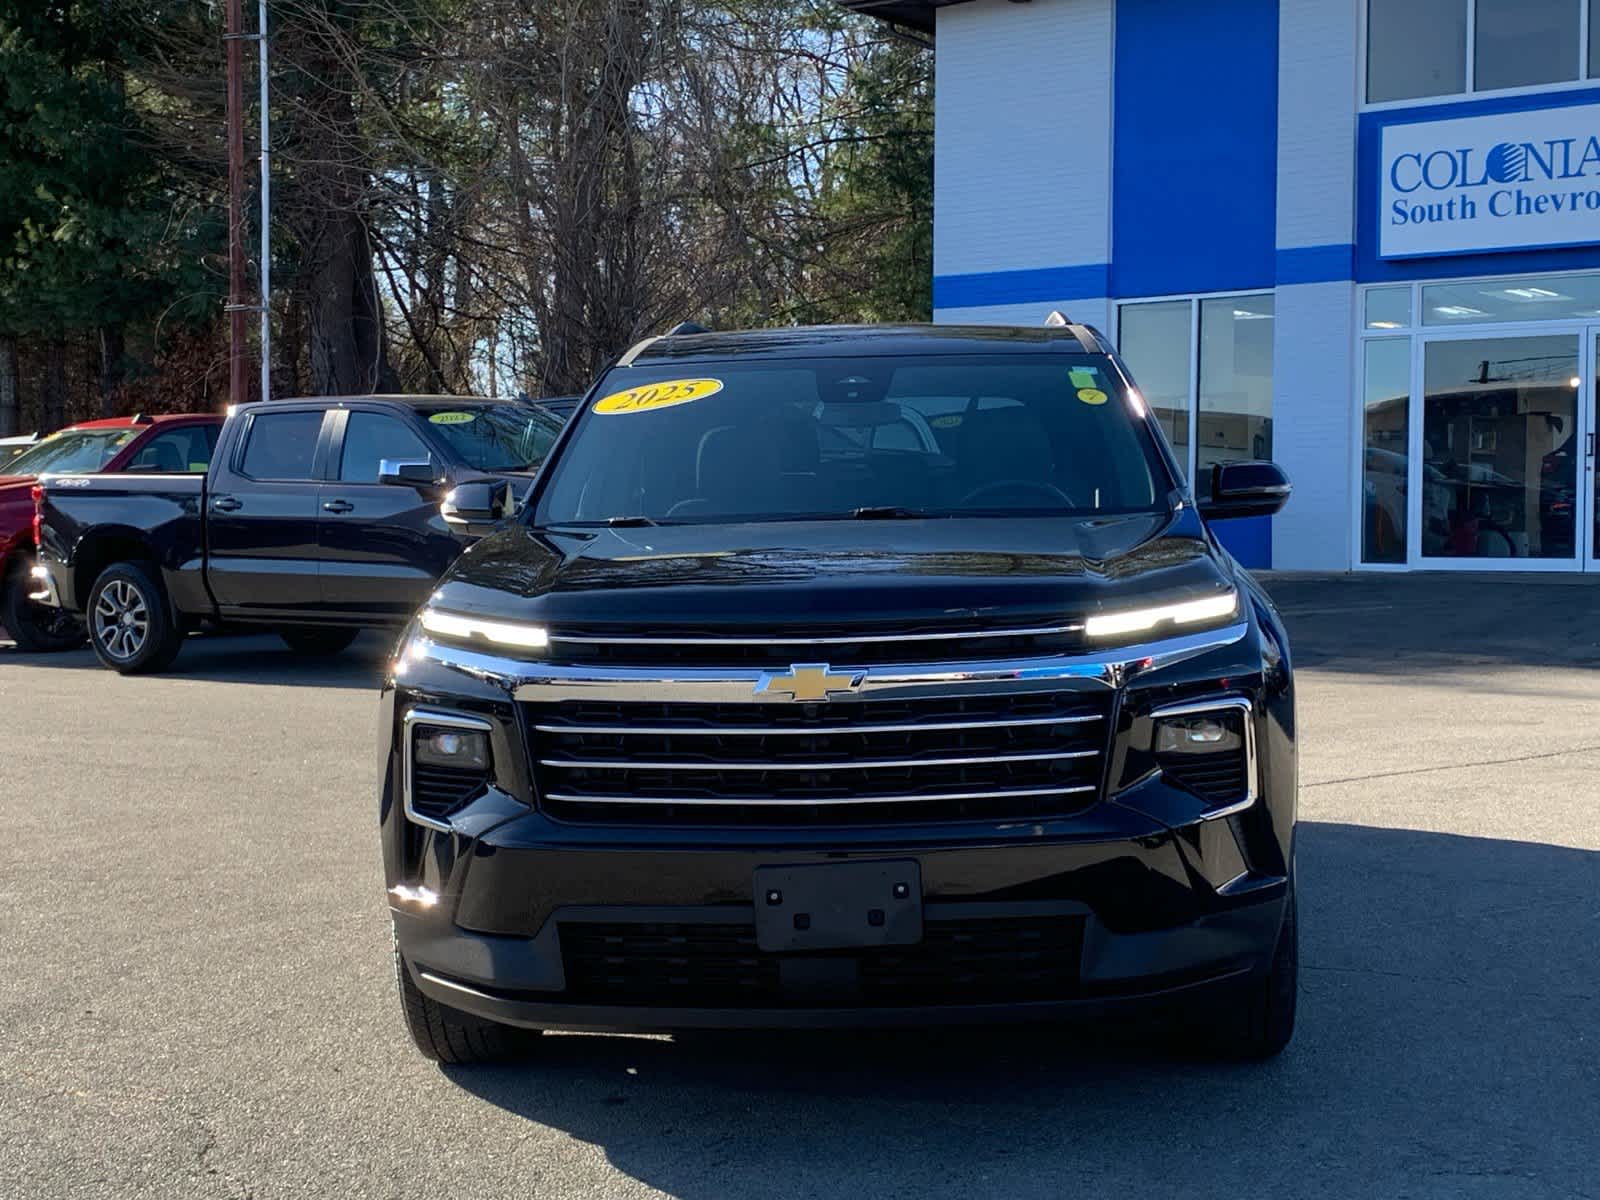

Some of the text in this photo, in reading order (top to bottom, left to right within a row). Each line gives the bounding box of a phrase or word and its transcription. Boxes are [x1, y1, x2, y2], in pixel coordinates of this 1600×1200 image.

[1391, 189, 1600, 226] South Chevro
[615, 382, 701, 410] 2025
